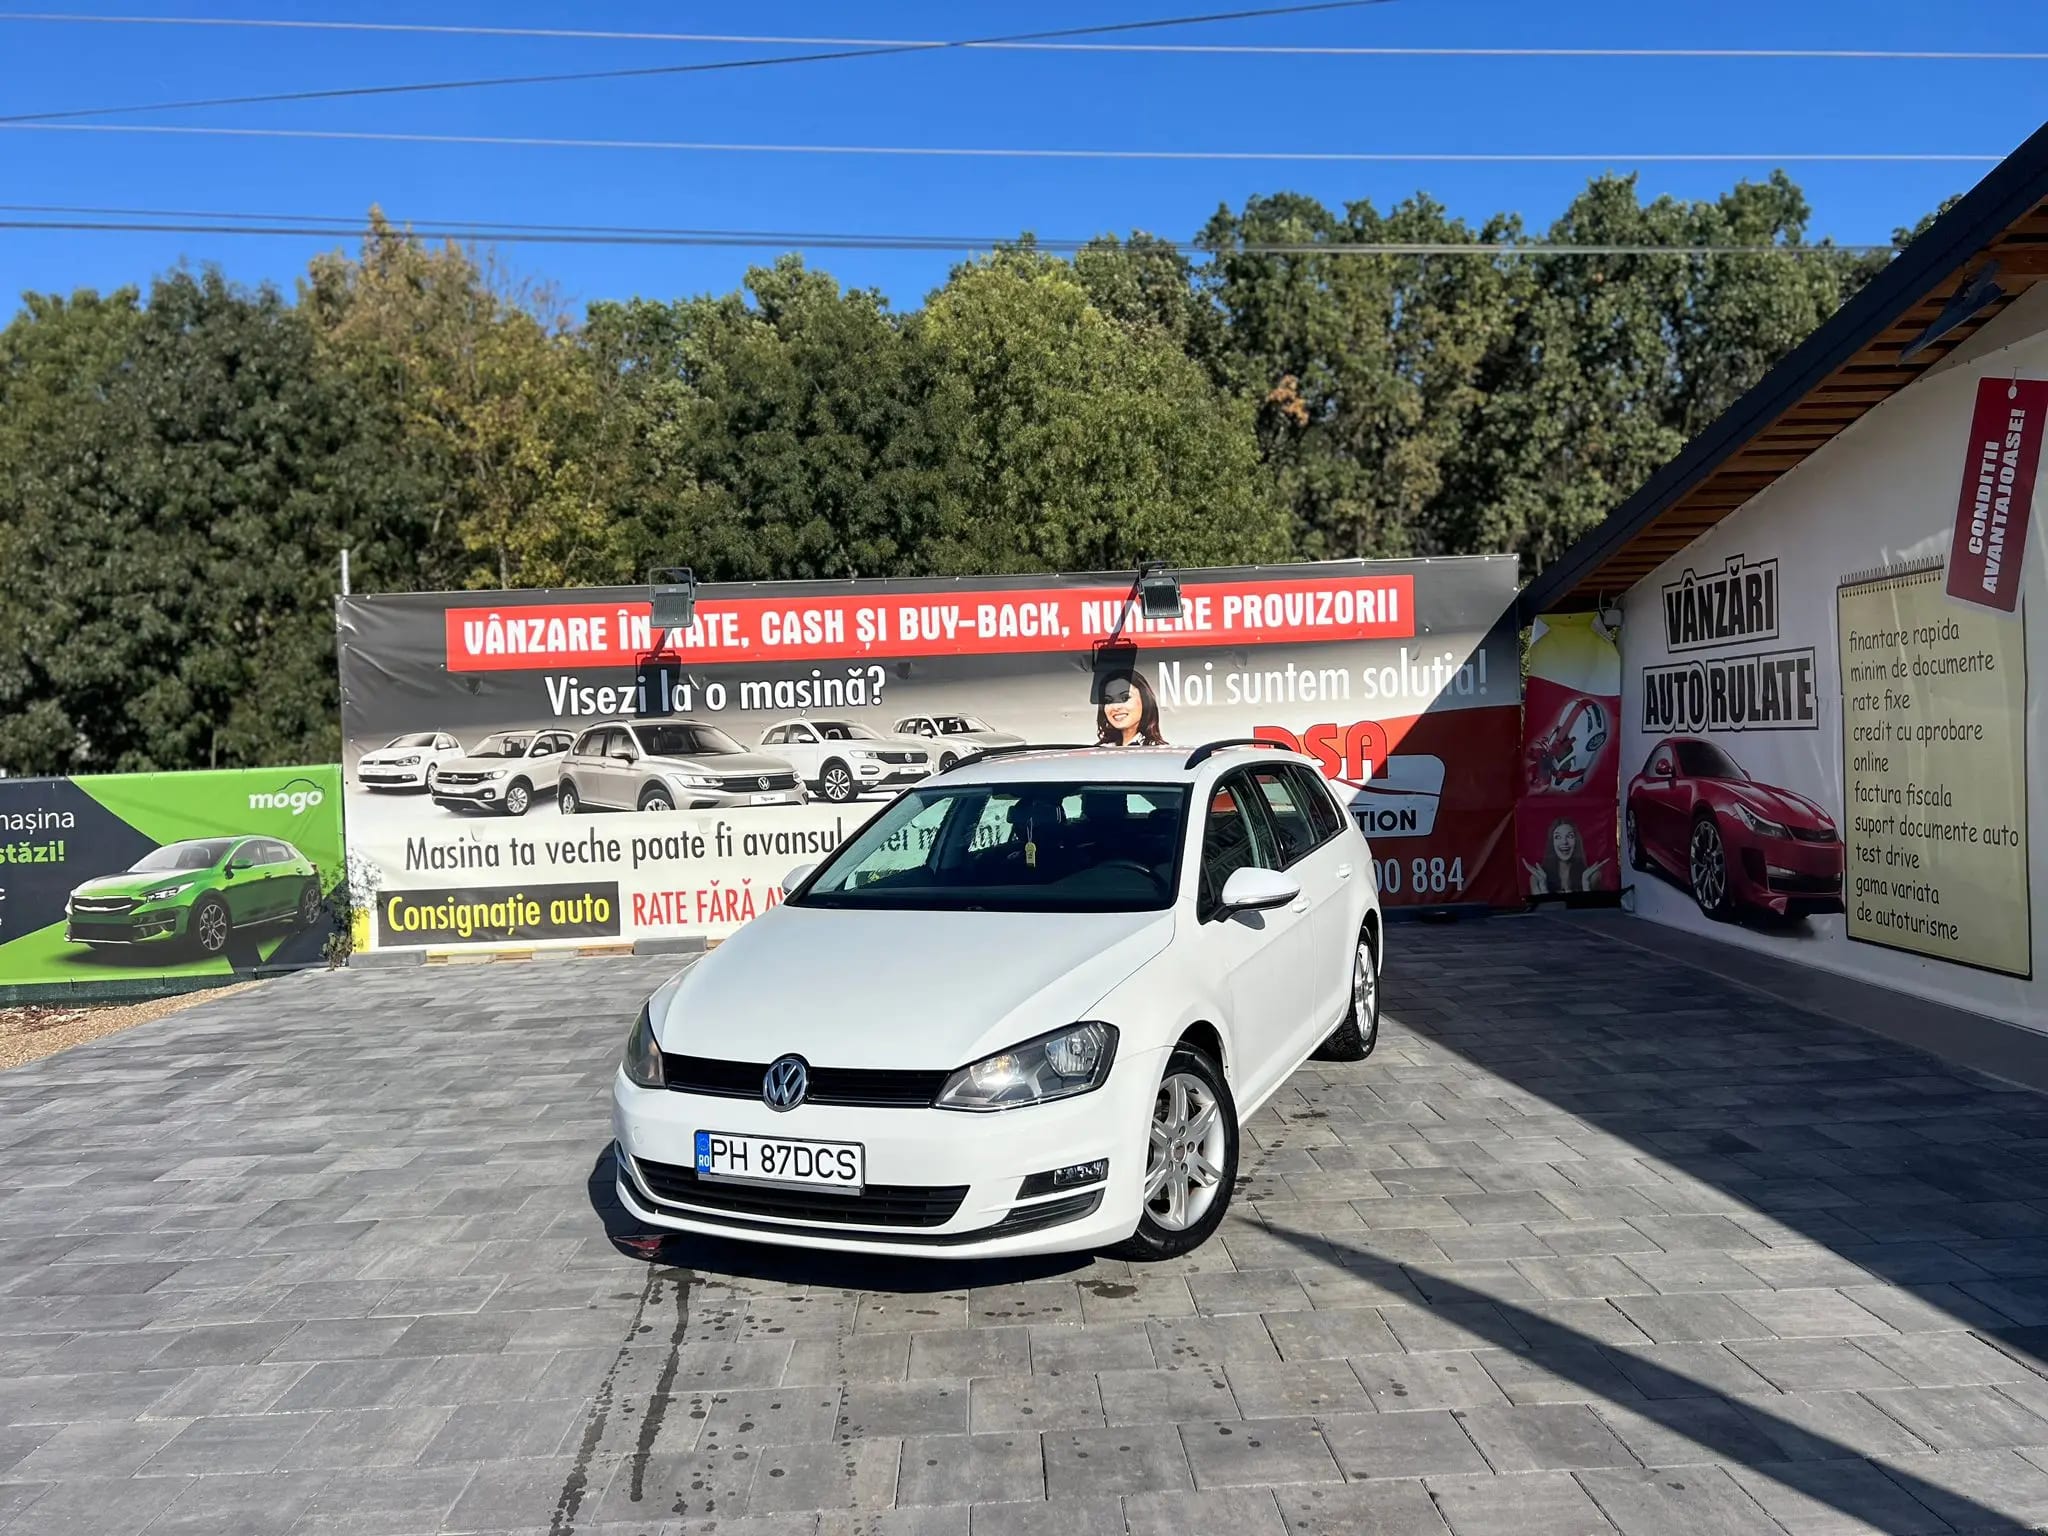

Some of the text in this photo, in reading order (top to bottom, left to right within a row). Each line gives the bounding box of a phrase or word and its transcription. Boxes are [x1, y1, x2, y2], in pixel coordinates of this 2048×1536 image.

[1968, 441, 2000, 555] CONDITII
[1981, 408, 2026, 595] AVANTAJOASE!
[464, 613, 607, 655] VÂNZARE
[617, 609, 651, 650] ÎN
[761, 609, 844, 646] CASH
[856, 607, 887, 651] ȘI
[899, 602, 1070, 641] BUY-BACK,
[1223, 588, 1398, 629] PROVIZORII
[1667, 565, 1774, 645] VÂNZĂRI
[1849, 616, 1960, 653] finantare rapida
[1158, 661, 1213, 707] Noi
[1226, 663, 1350, 705] suntem
[1850, 650, 1995, 682] minim de documente
[544, 675, 646, 716] Visezi
[660, 668, 692, 713] la
[705, 681, 727, 711] o
[1645, 657, 1813, 726] AUTO RULATE
[1852, 688, 1911, 712] rate fixe
[1853, 717, 1984, 748] credit cu aprobare
[1853, 750, 1889, 772] online
[248, 790, 323, 816] mogo
[1855, 780, 1952, 807] factura fiscala
[405, 837, 500, 870] Masina
[509, 837, 535, 866] ta
[545, 827, 621, 865] veche
[631, 831, 705, 869] poate
[715, 821, 732, 858] fi
[743, 816, 842, 857] avansul
[1855, 814, 2019, 847] suport documente auto
[1411, 856, 1464, 894] 884
[1856, 842, 1920, 869] test drive
[632, 890, 688, 926] RATE
[697, 878, 756, 923] FĂRĂ
[1856, 876, 1940, 905] gama variata
[387, 893, 610, 938] Consignație auto
[1856, 901, 1959, 941] de autoturisme
[698, 1138, 857, 1180] RO PH 87DCS
